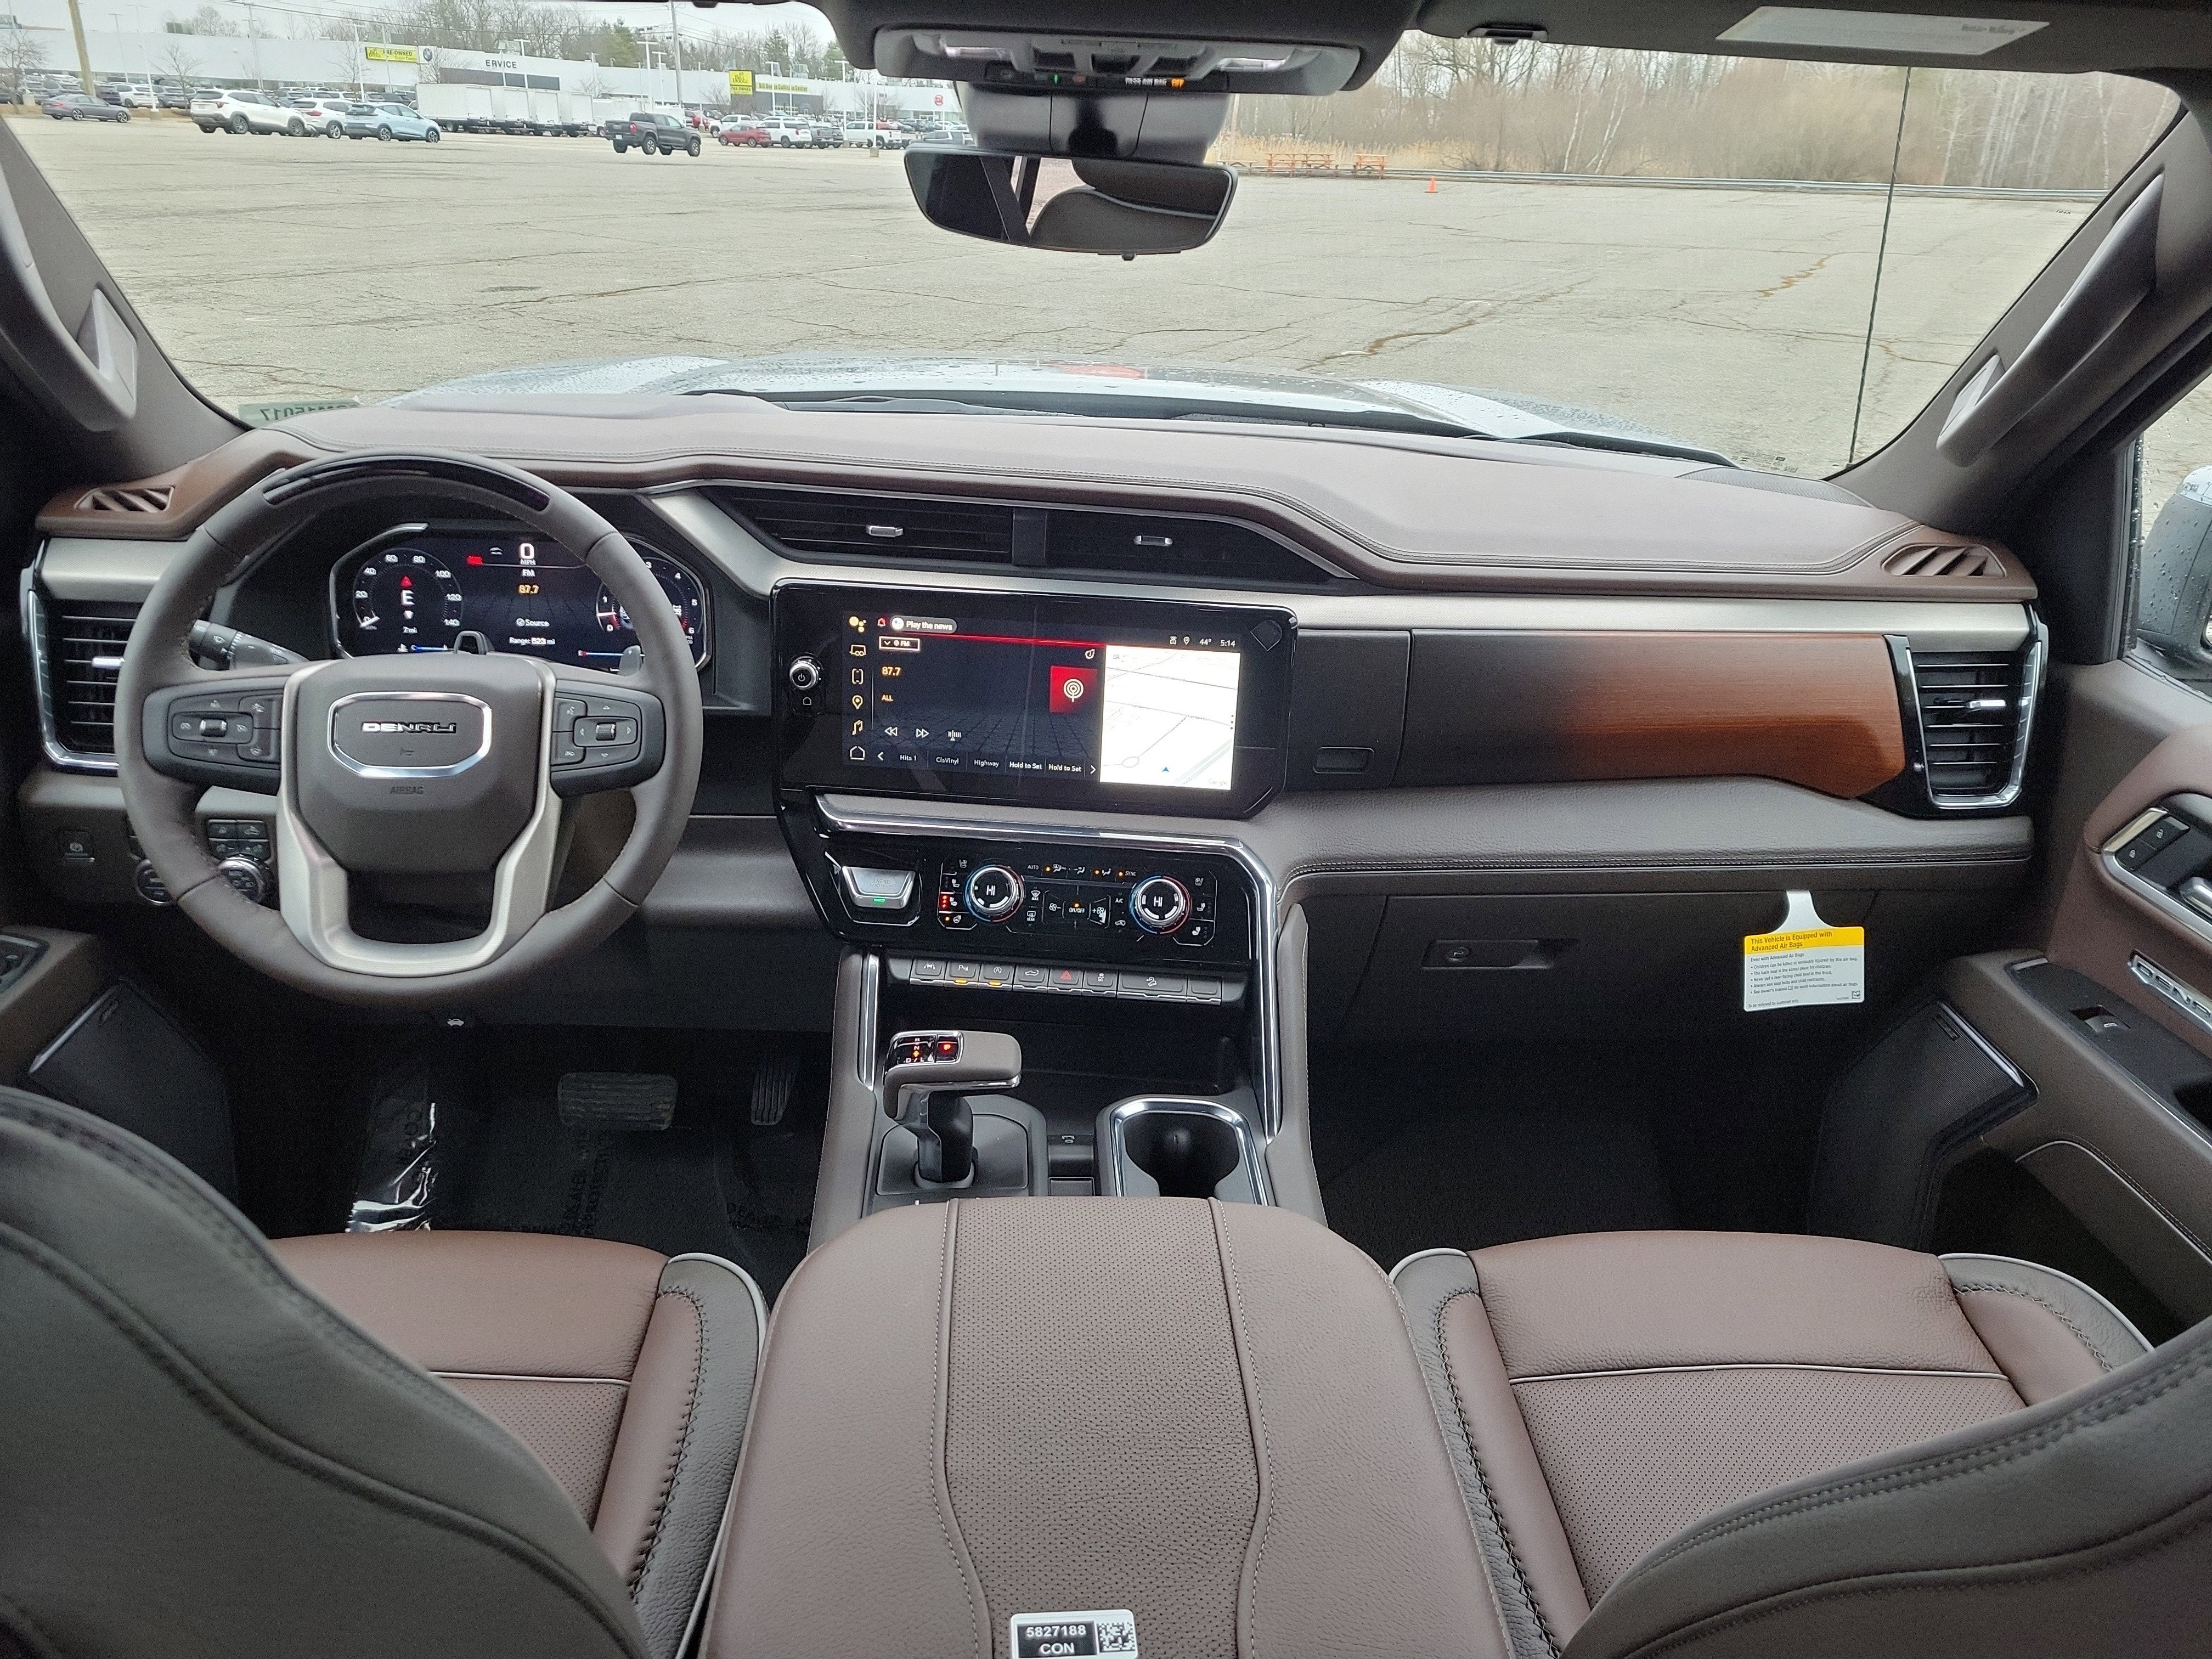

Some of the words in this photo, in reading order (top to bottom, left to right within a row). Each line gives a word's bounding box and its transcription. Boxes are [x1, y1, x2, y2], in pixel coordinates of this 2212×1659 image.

[520, 543, 534, 559] 0
[364, 567, 377, 575] 40
[401, 590, 415, 606] E
[906, 620, 921, 630] Play
[509, 637, 531, 645] Range:
[882, 666, 901, 676] 87.7
[362, 722, 457, 733] DENALI
[974, 759, 1000, 768] Highway
[390, 786, 424, 795] AIRBAG
[986, 885, 996, 896] HI
[1153, 896, 1163, 907] HI
[1792, 932, 1818, 940] Equipped
[1026, 1625, 1087, 1638] 5827188
[1040, 1643, 1075, 1655] CON
